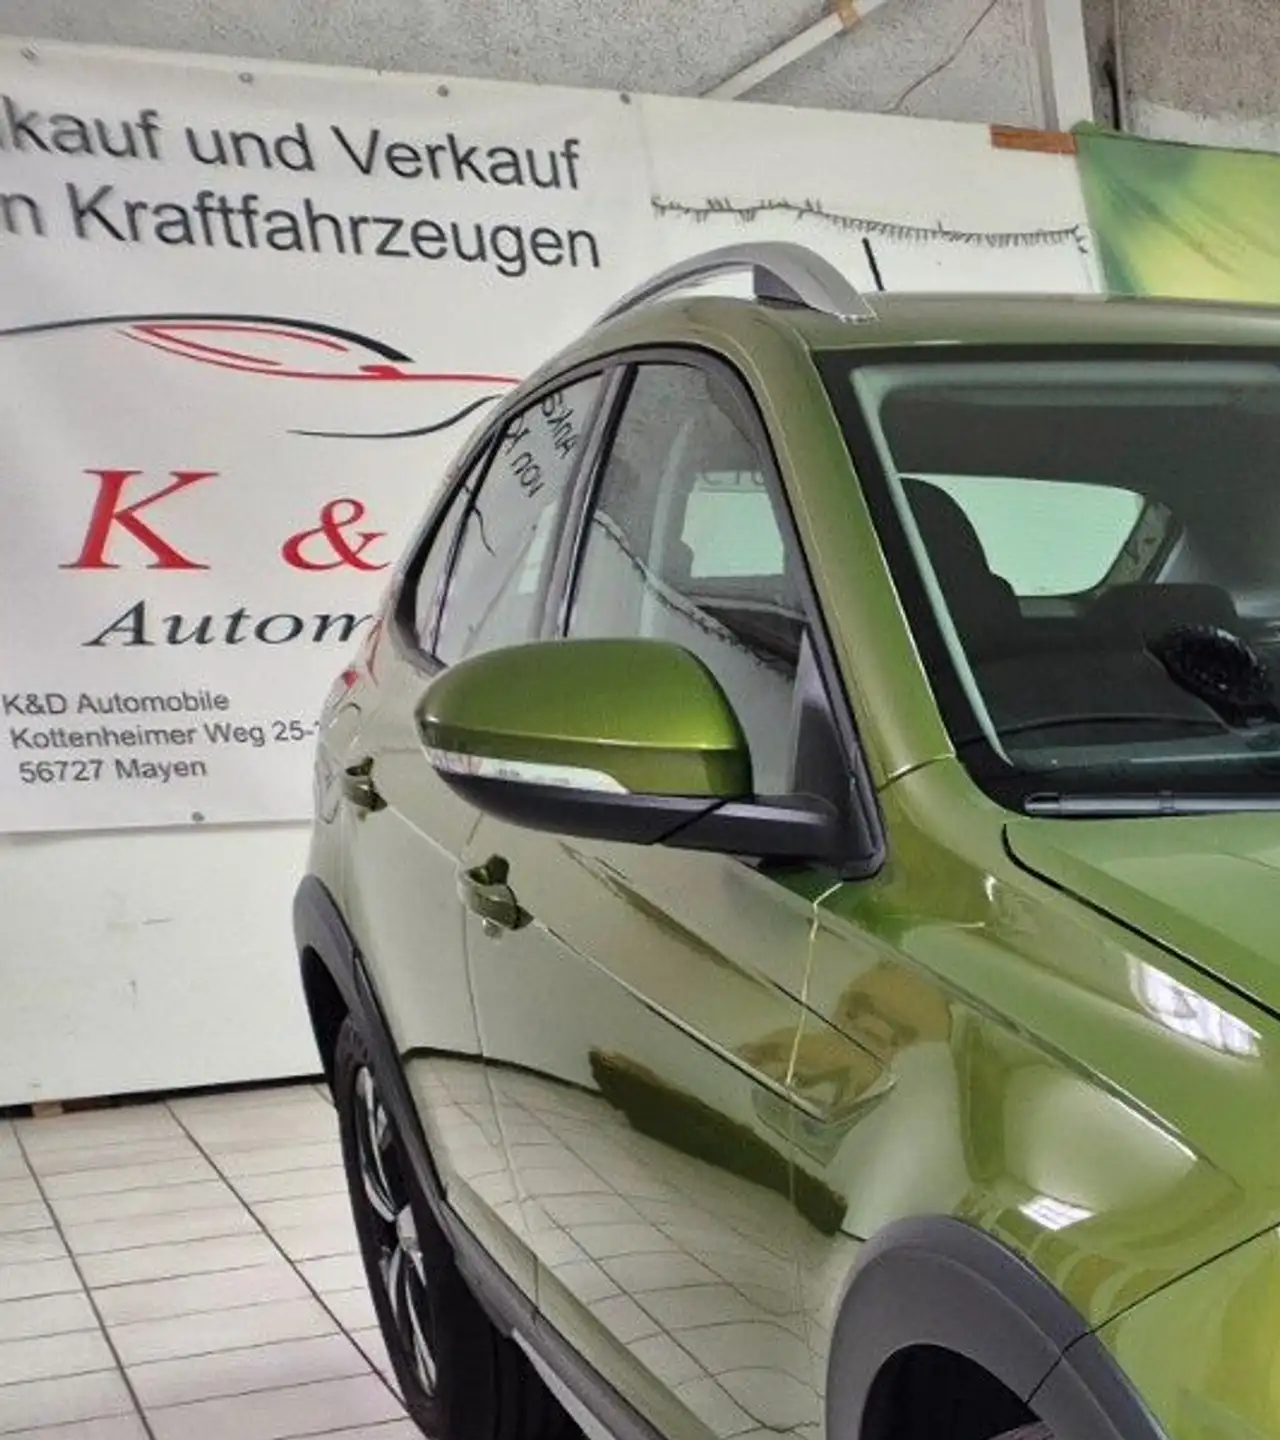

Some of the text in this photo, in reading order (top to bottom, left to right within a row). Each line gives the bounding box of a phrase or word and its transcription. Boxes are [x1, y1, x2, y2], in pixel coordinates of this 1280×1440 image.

[0, 95, 581, 192] kauf und Verkauf
[65, 180, 602, 279] Kraftfahrzeugen
[57, 468, 391, 573] K &
[1, 690, 230, 716] K&D Automobile
[9, 720, 321, 750] Kottenheimer Weg 25-
[18, 757, 209, 785] 56727 Mayen
